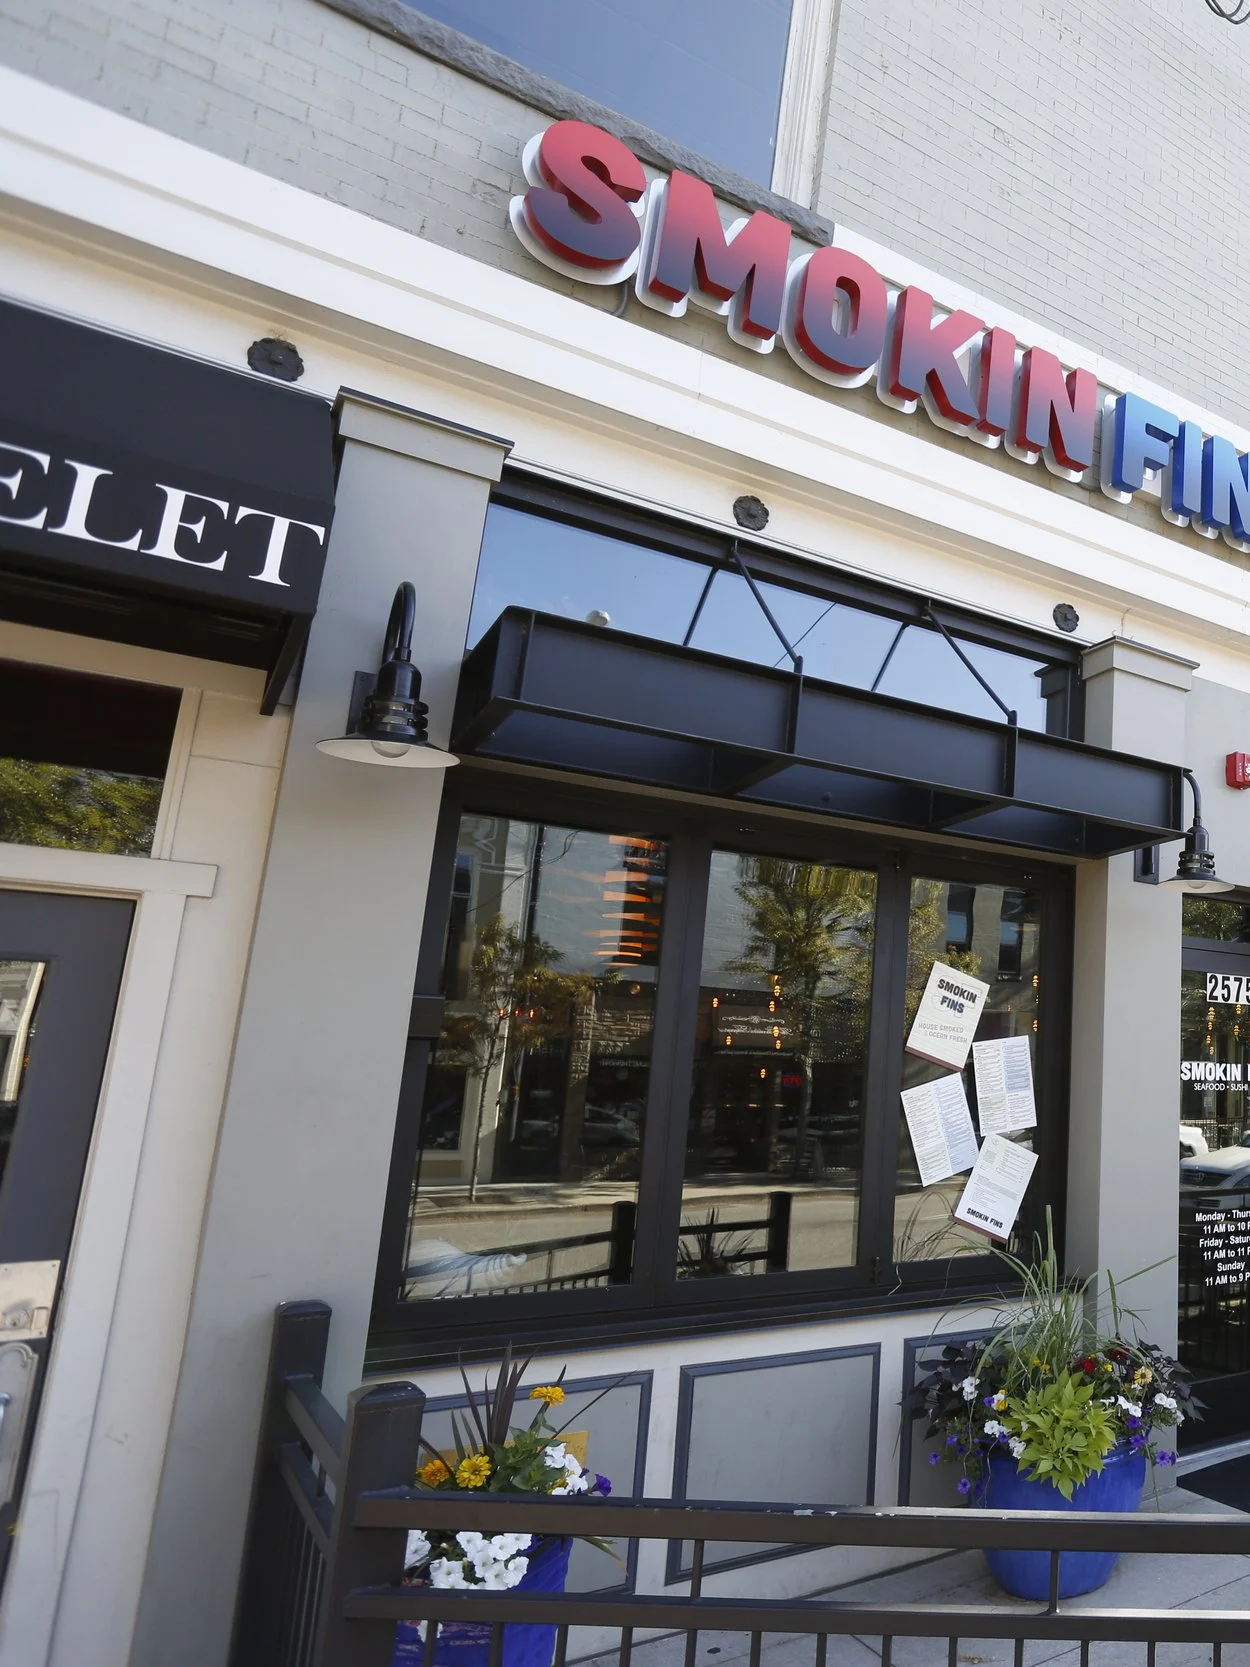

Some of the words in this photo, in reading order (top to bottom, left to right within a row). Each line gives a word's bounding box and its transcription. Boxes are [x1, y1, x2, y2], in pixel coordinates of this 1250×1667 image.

[523, 119, 1098, 473] SMOKIN
[937, 978, 978, 1004] SMOKIN
[940, 995, 965, 1013] FINS
[918, 1023, 938, 1031] HOUSE
[940, 1024, 964, 1033] SMOKED
[949, 1034, 968, 1043] FRESH
[1180, 1062, 1242, 1081] SMOKIN
[1194, 1083, 1225, 1091] SEAFOOD
[1230, 1083, 1249, 1091] SUSHI
[966, 1207, 990, 1223] SMOKIN
[989, 1217, 1004, 1229] FINS
[1195, 1211, 1226, 1222] Monday
[1203, 1225, 1211, 1234] 11
[1213, 1224, 1226, 1233] AM
[1227, 1223, 1235, 1232] to
[1237, 1222, 1246, 1231] 10
[1199, 1237, 1223, 1248] Friday
[1203, 1251, 1211, 1260] 11
[1213, 1249, 1226, 1259] AM
[1227, 1249, 1235, 1257] to
[1237, 1247, 1245, 1256] 11
[1217, 1260, 1246, 1272] Sunday
[1205, 1277, 1213, 1286] 11
[1215, 1275, 1228, 1285] AM
[1229, 1275, 1237, 1283] to
[1238, 1273, 1243, 1282] 9
